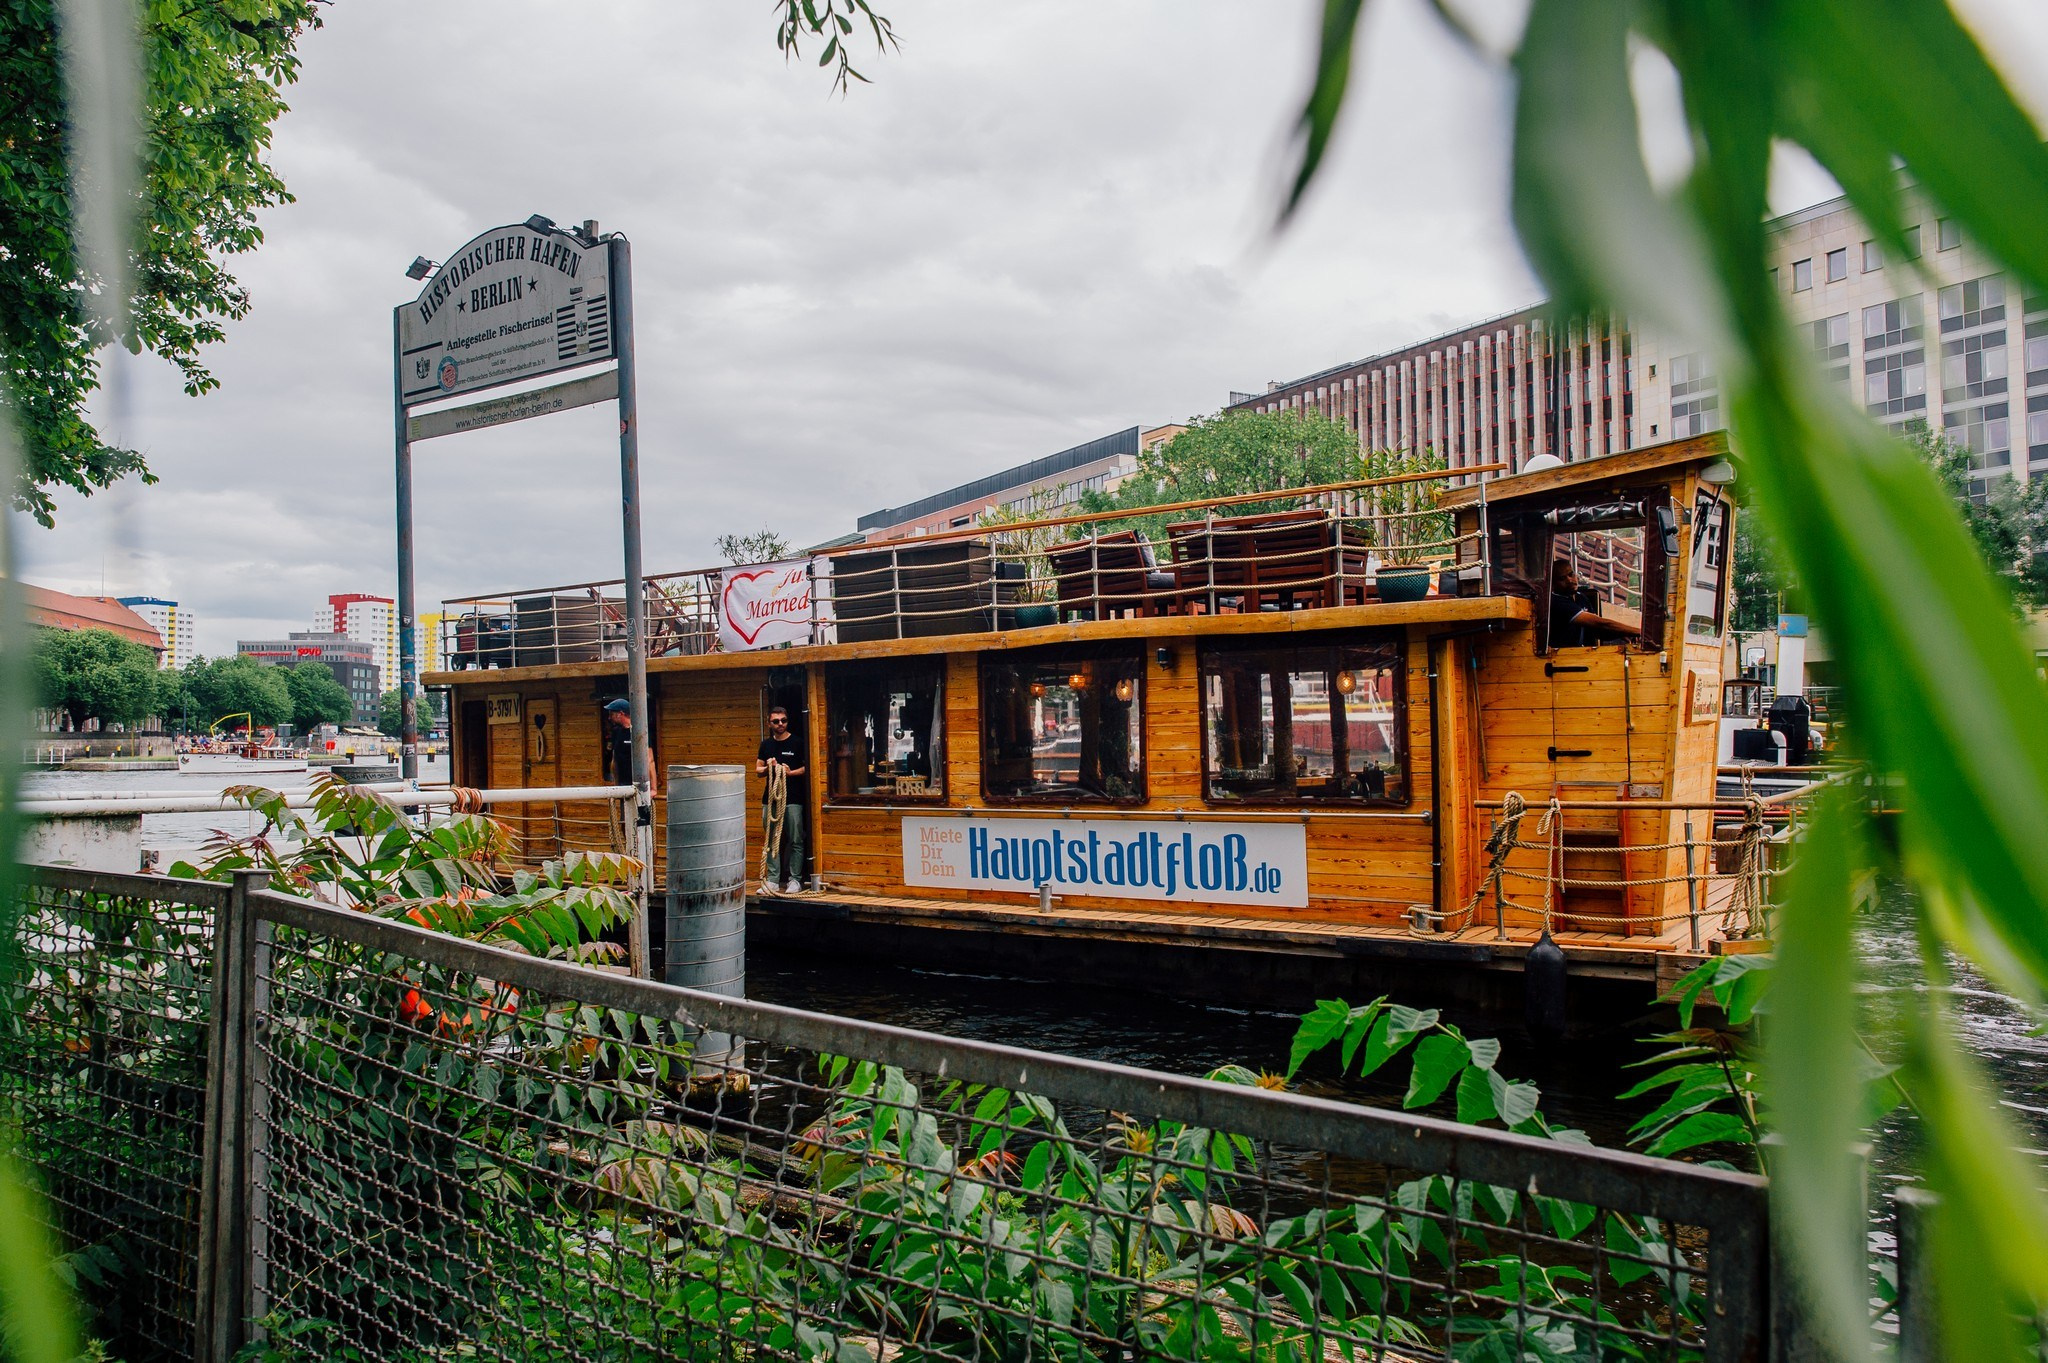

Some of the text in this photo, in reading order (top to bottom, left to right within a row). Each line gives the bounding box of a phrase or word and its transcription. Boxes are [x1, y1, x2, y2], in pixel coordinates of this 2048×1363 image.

[420, 236, 582, 325] HISTORISCHER HAFEN
[470, 275, 523, 313] BERLIN
[446, 313, 554, 351] Anlegestelle Fischerinsel
[455, 398, 563, 429] www.historischer-hafen-berlin.de
[745, 587, 812, 621] Married
[920, 826, 963, 844] Miete
[921, 843, 943, 860] Dir
[921, 860, 956, 877] Dein
[968, 826, 1282, 896] Hauptstadtfloß.de
